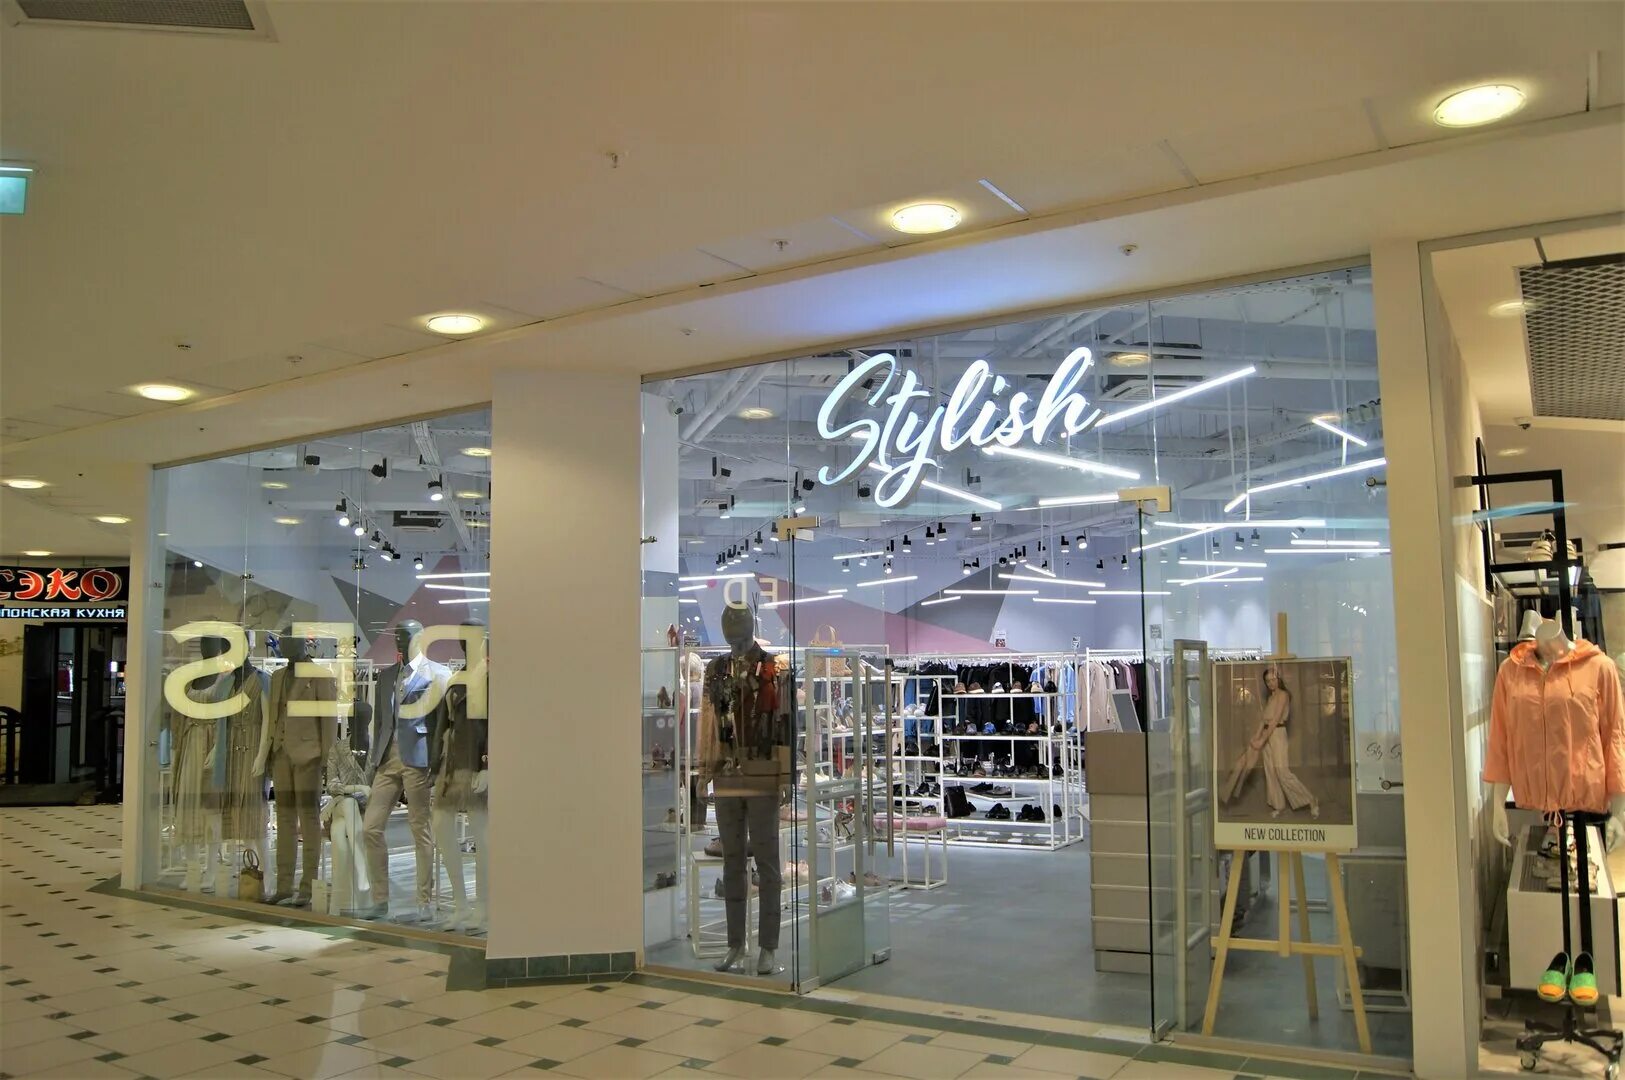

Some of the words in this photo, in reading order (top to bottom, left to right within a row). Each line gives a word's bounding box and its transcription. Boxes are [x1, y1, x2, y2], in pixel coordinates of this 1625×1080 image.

[817, 347, 1100, 508] Stylish
[76, 608, 125, 618] КУХНЯ
[1244, 828, 1265, 841] NEW
[1268, 829, 1326, 842] COLLECTION
